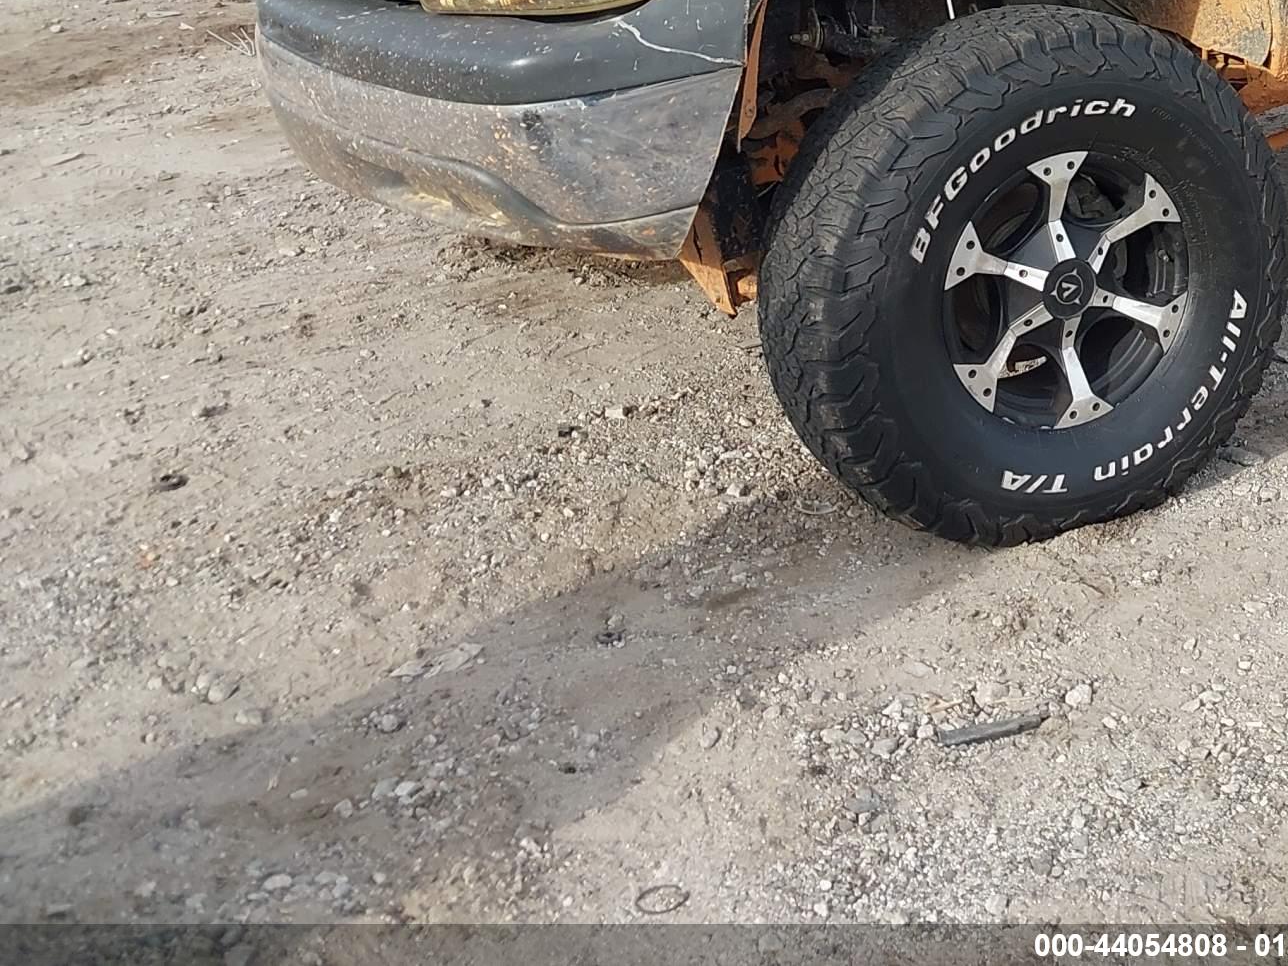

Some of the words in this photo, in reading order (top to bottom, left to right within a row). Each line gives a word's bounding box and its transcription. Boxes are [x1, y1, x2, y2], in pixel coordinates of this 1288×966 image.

[909, 98, 1136, 264] BFGoodrich
[1093, 289, 1248, 482] All-Terrain
[1001, 470, 1068, 493] T/A
